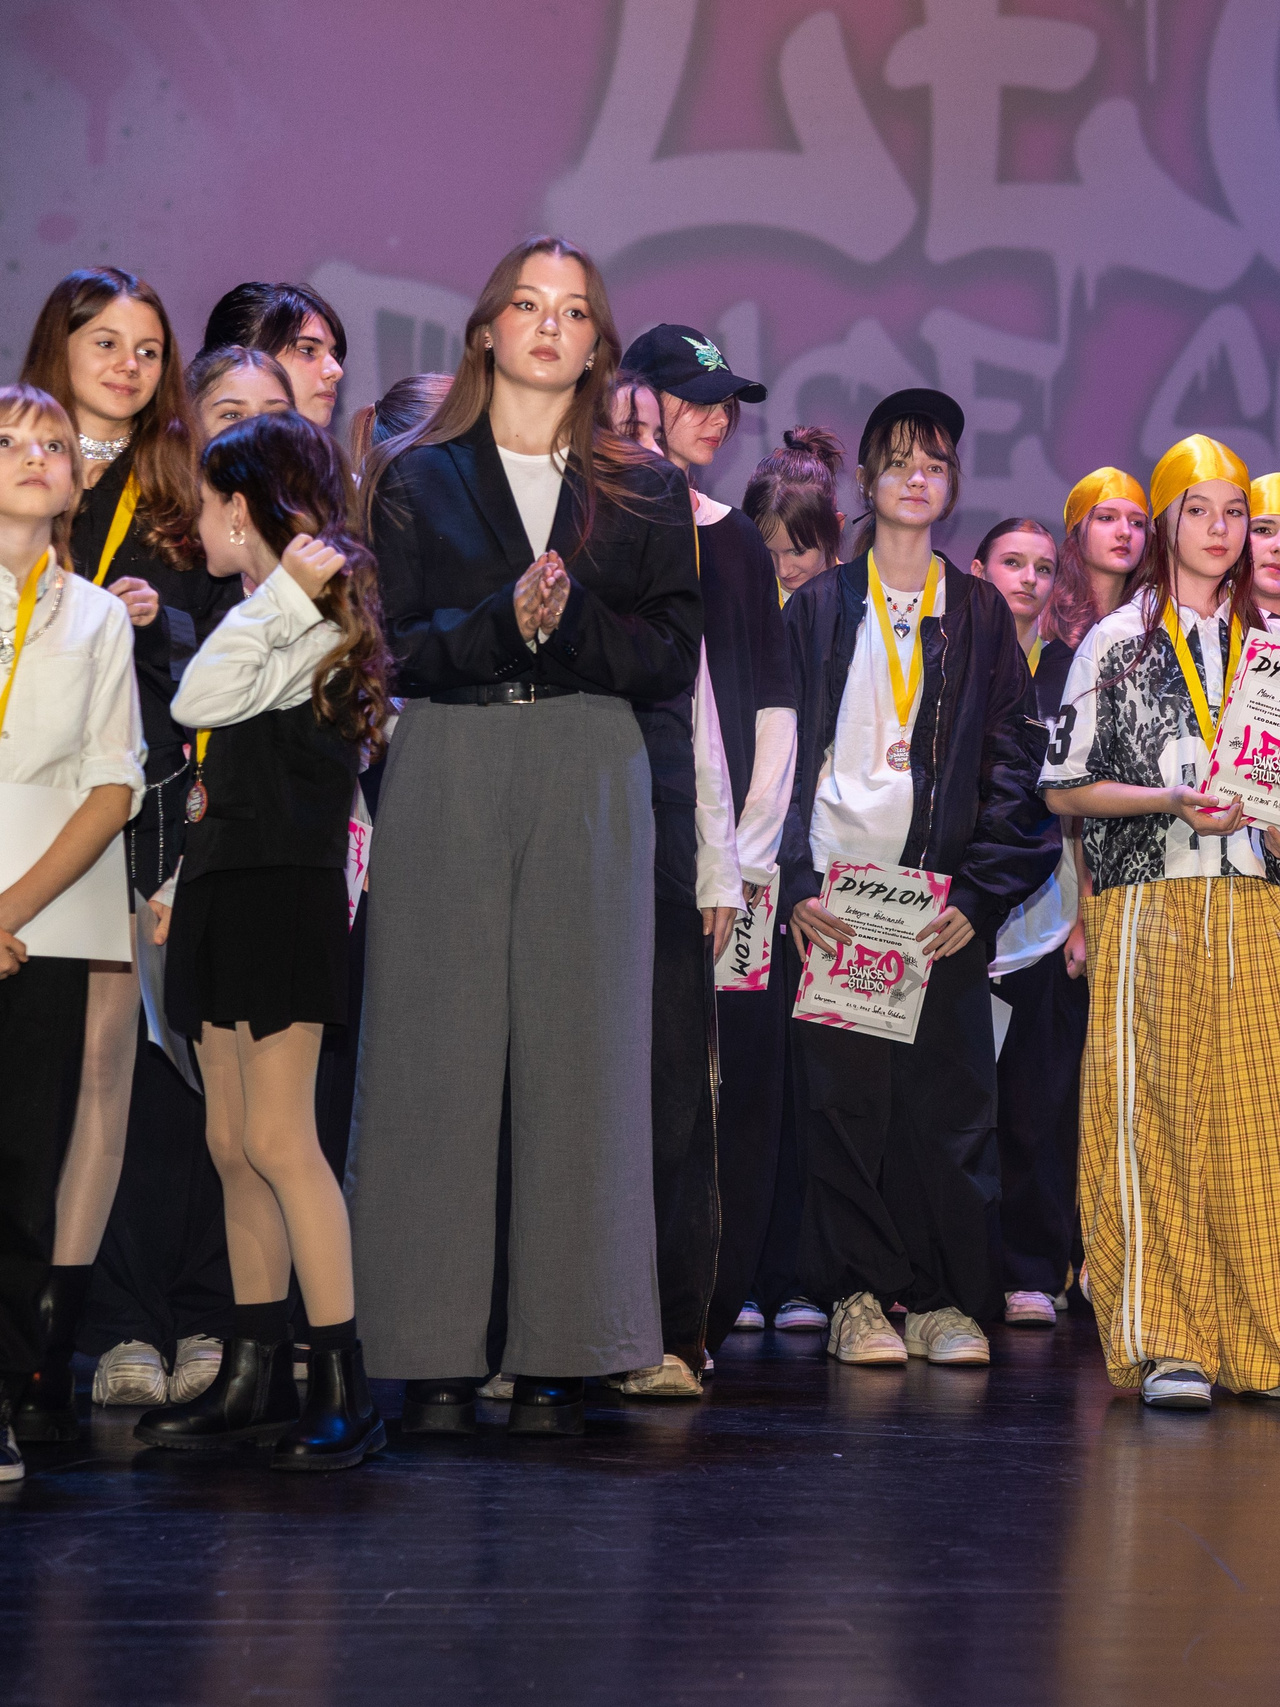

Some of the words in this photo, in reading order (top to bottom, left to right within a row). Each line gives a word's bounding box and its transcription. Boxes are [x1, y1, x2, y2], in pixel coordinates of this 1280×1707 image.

[1047, 704, 1077, 766] 3
[834, 876, 934, 912] DYPLOM
[878, 938, 902, 946] STUDIO
[828, 942, 905, 985] LEO
[849, 965, 886, 981] DANCE
[848, 976, 885, 992] STUDIO
